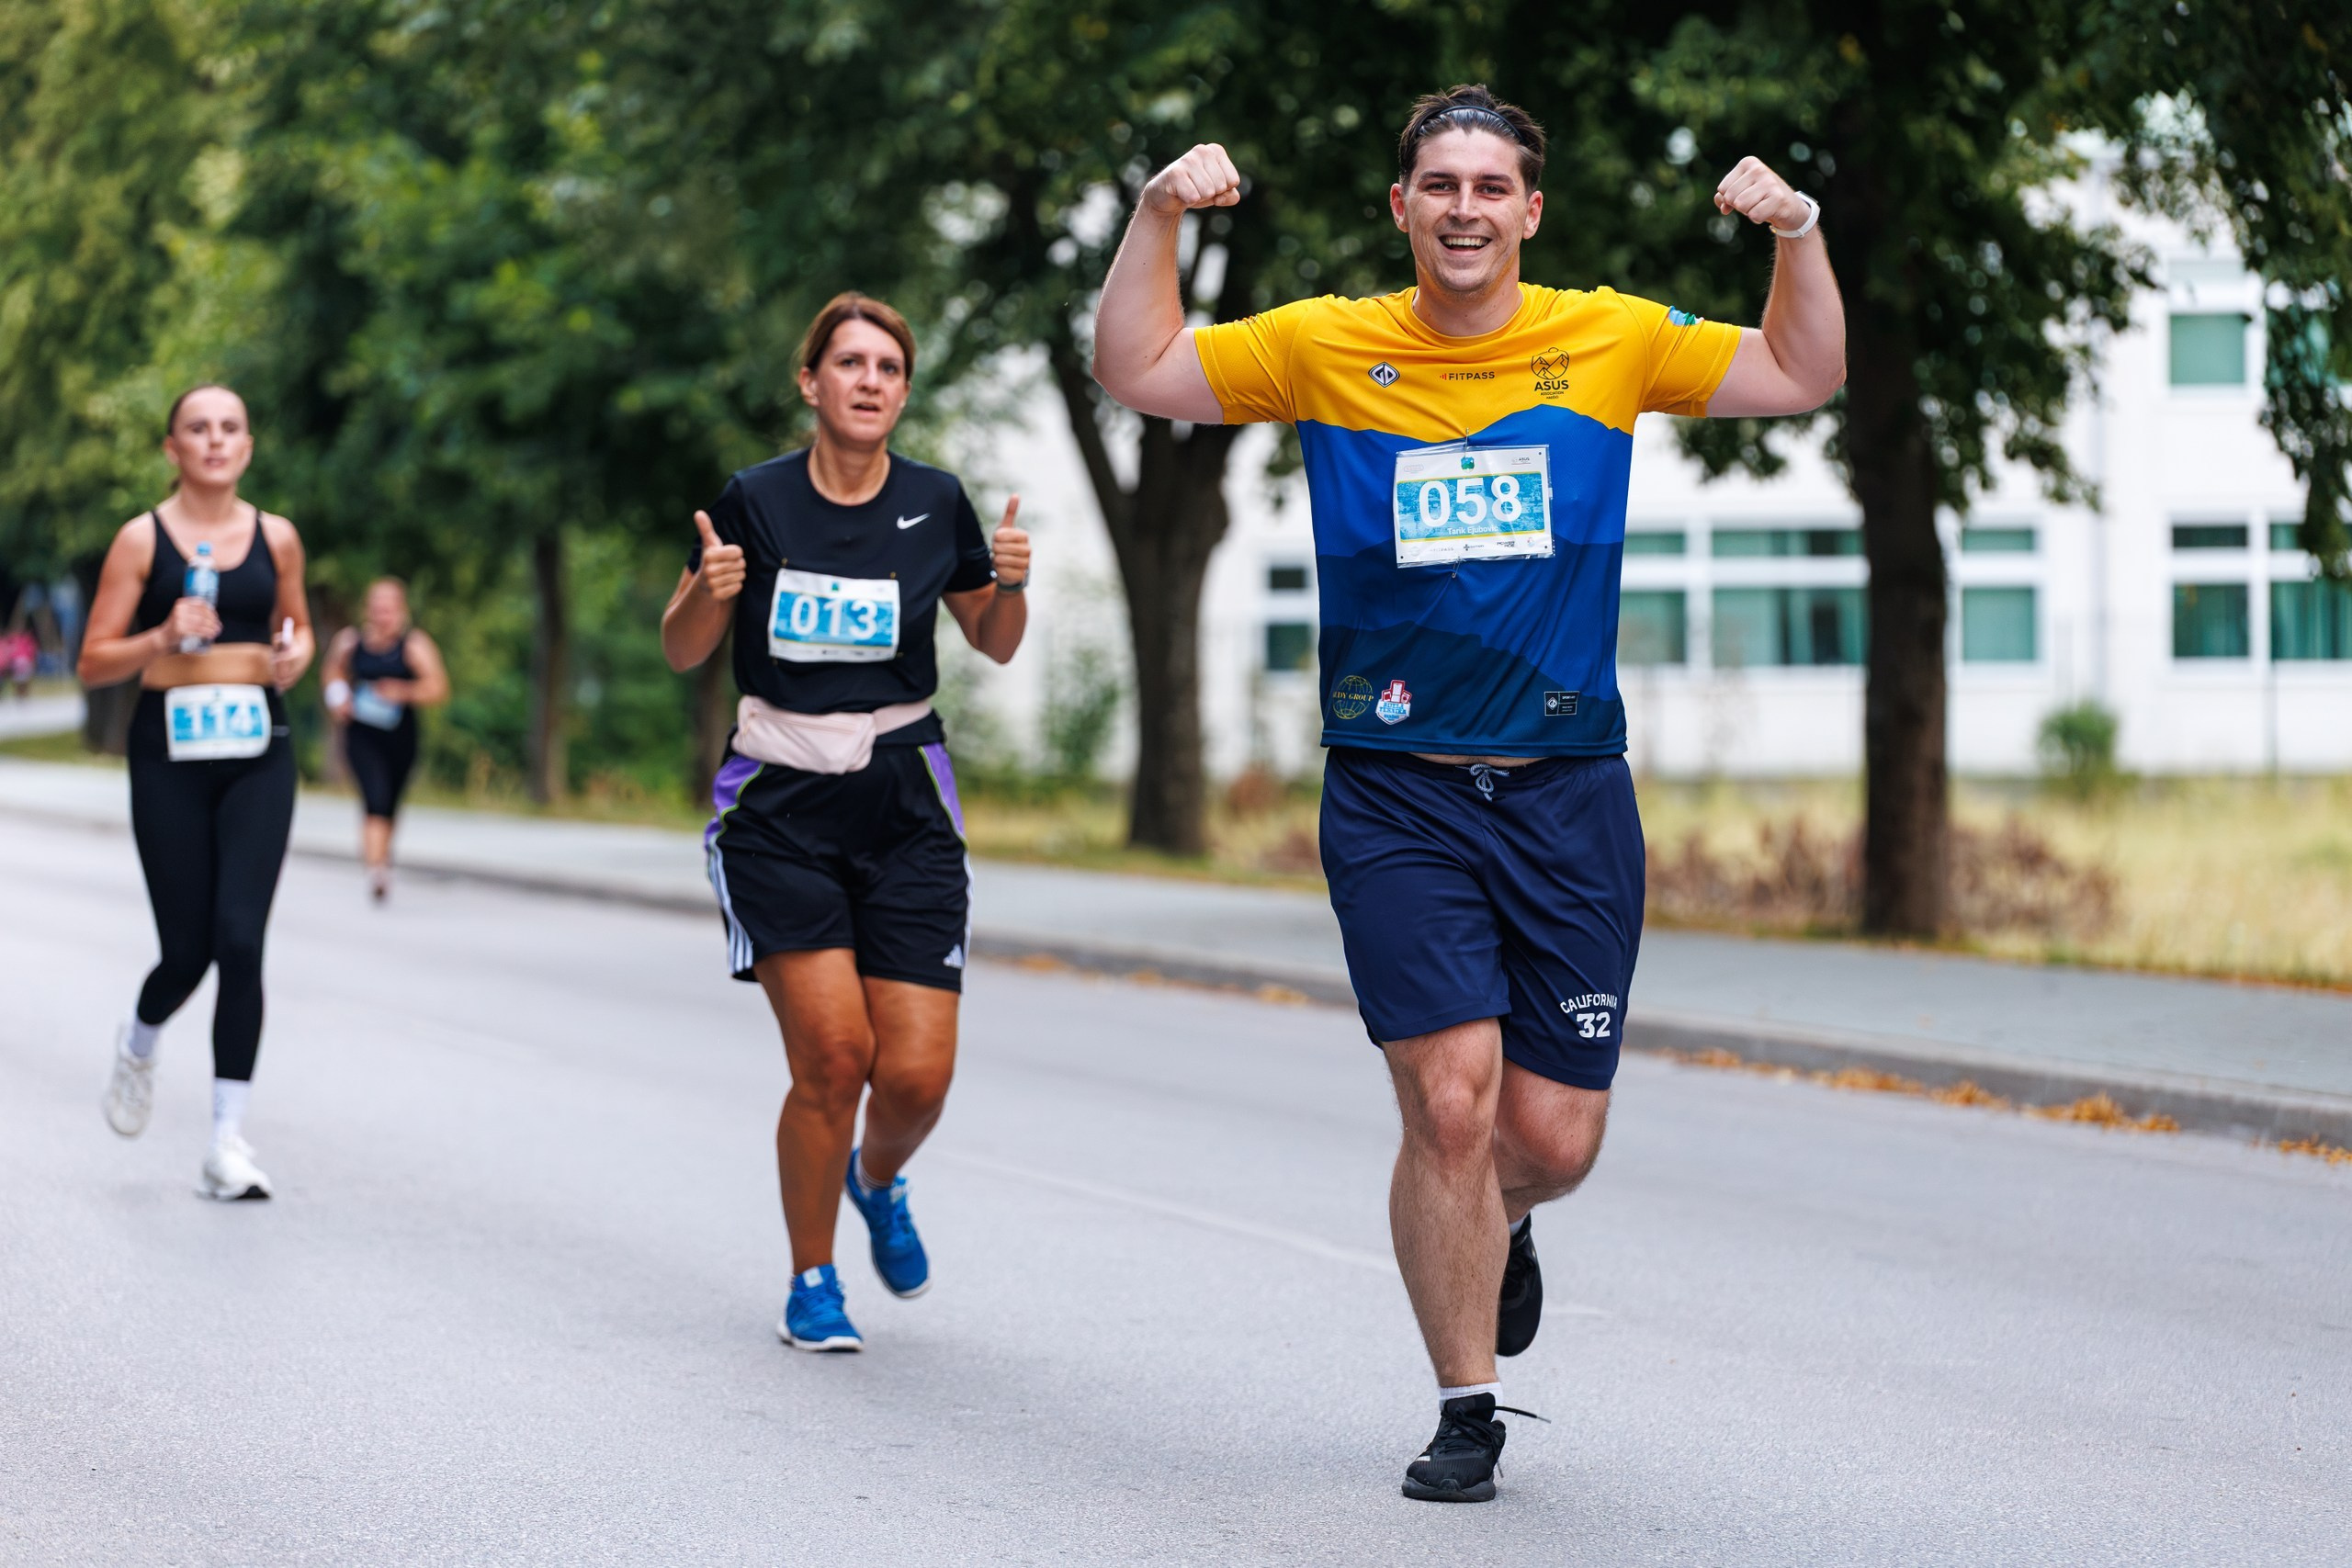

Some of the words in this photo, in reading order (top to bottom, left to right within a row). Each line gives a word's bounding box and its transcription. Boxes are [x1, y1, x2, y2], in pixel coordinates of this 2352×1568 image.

[1448, 371, 1496, 381] FITPASS
[1534, 379, 1569, 391] ASUS
[1419, 475, 1522, 527] 058
[1447, 526, 1466, 536] Tarik
[790, 595, 878, 640] 013
[1348, 693, 1374, 702] GROUP
[185, 703, 254, 737] 114
[1559, 993, 1618, 1014] CALIFORNIA
[1576, 1011, 1611, 1039] 32
